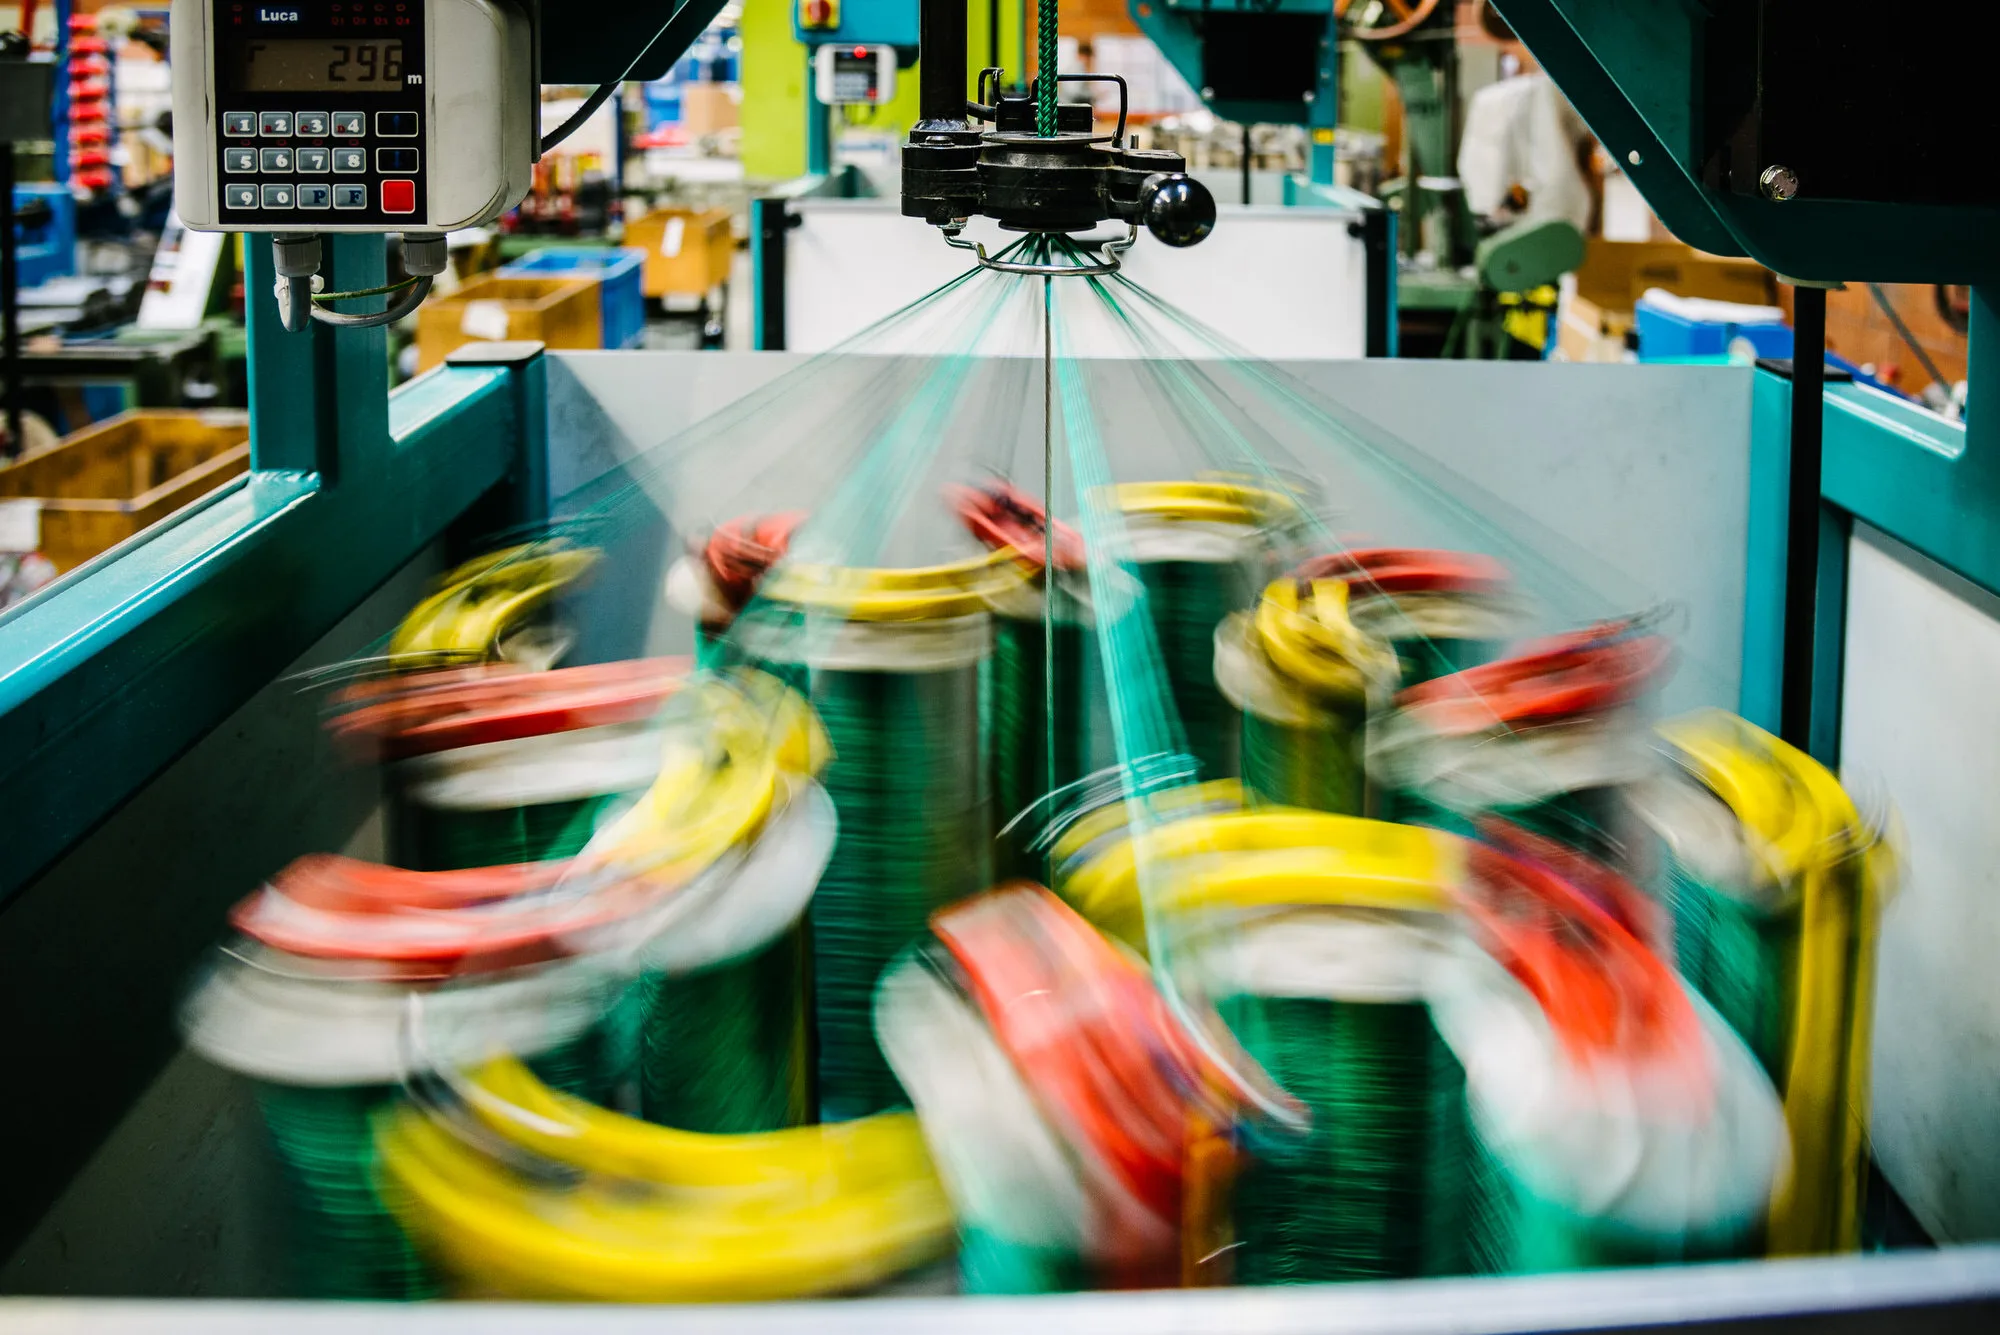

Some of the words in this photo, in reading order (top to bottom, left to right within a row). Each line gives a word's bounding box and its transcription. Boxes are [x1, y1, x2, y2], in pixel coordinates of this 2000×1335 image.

[261, 9, 298, 21] Luca
[328, 45, 402, 82] 296
[407, 74, 422, 84] m
[229, 125, 237, 133] A
[240, 119, 250, 132] 1
[275, 119, 287, 132] 2
[311, 119, 323, 132] 3
[347, 119, 359, 132] 4
[240, 155, 252, 169] 5
[275, 154, 288, 167] 6
[311, 155, 323, 169] 7
[348, 154, 360, 167] 8
[241, 191, 253, 205] 9
[313, 190, 326, 204] P
[348, 190, 362, 204] F
